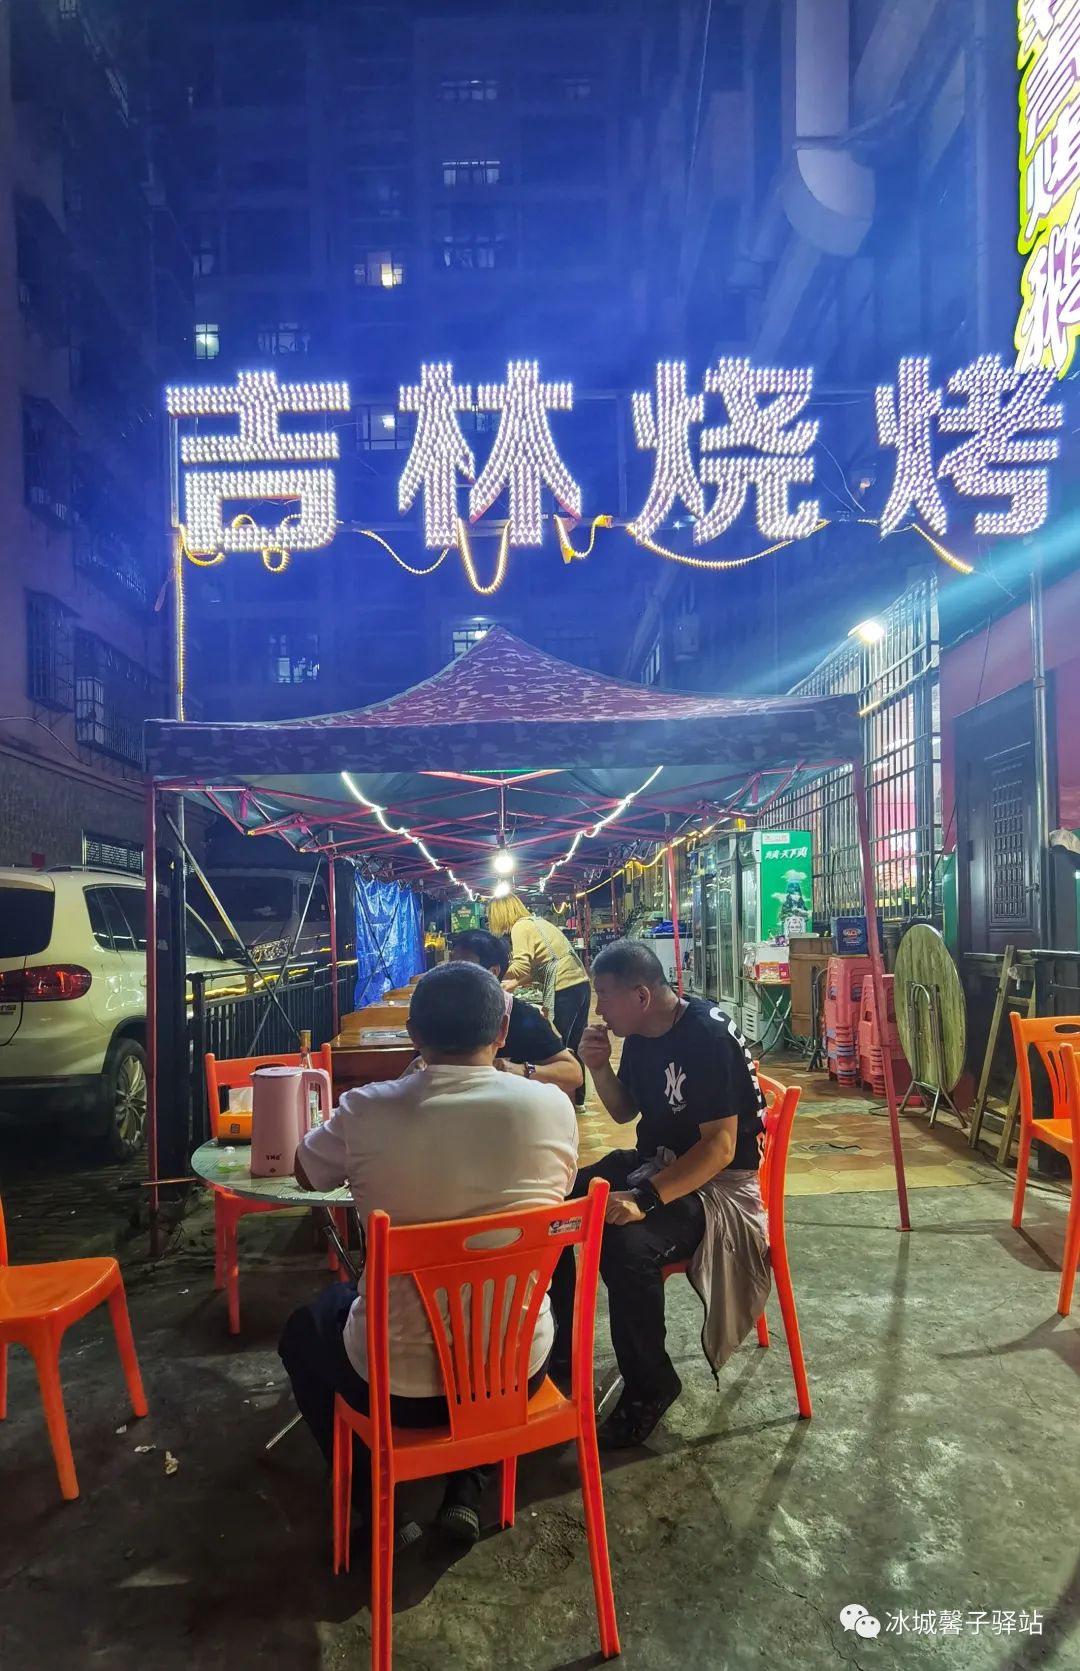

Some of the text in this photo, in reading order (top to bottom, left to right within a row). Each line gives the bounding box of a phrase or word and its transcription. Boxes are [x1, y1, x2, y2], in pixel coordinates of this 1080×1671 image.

[164, 354, 1066, 552] 吉林烧烤
[664, 1062, 687, 1105] NY
